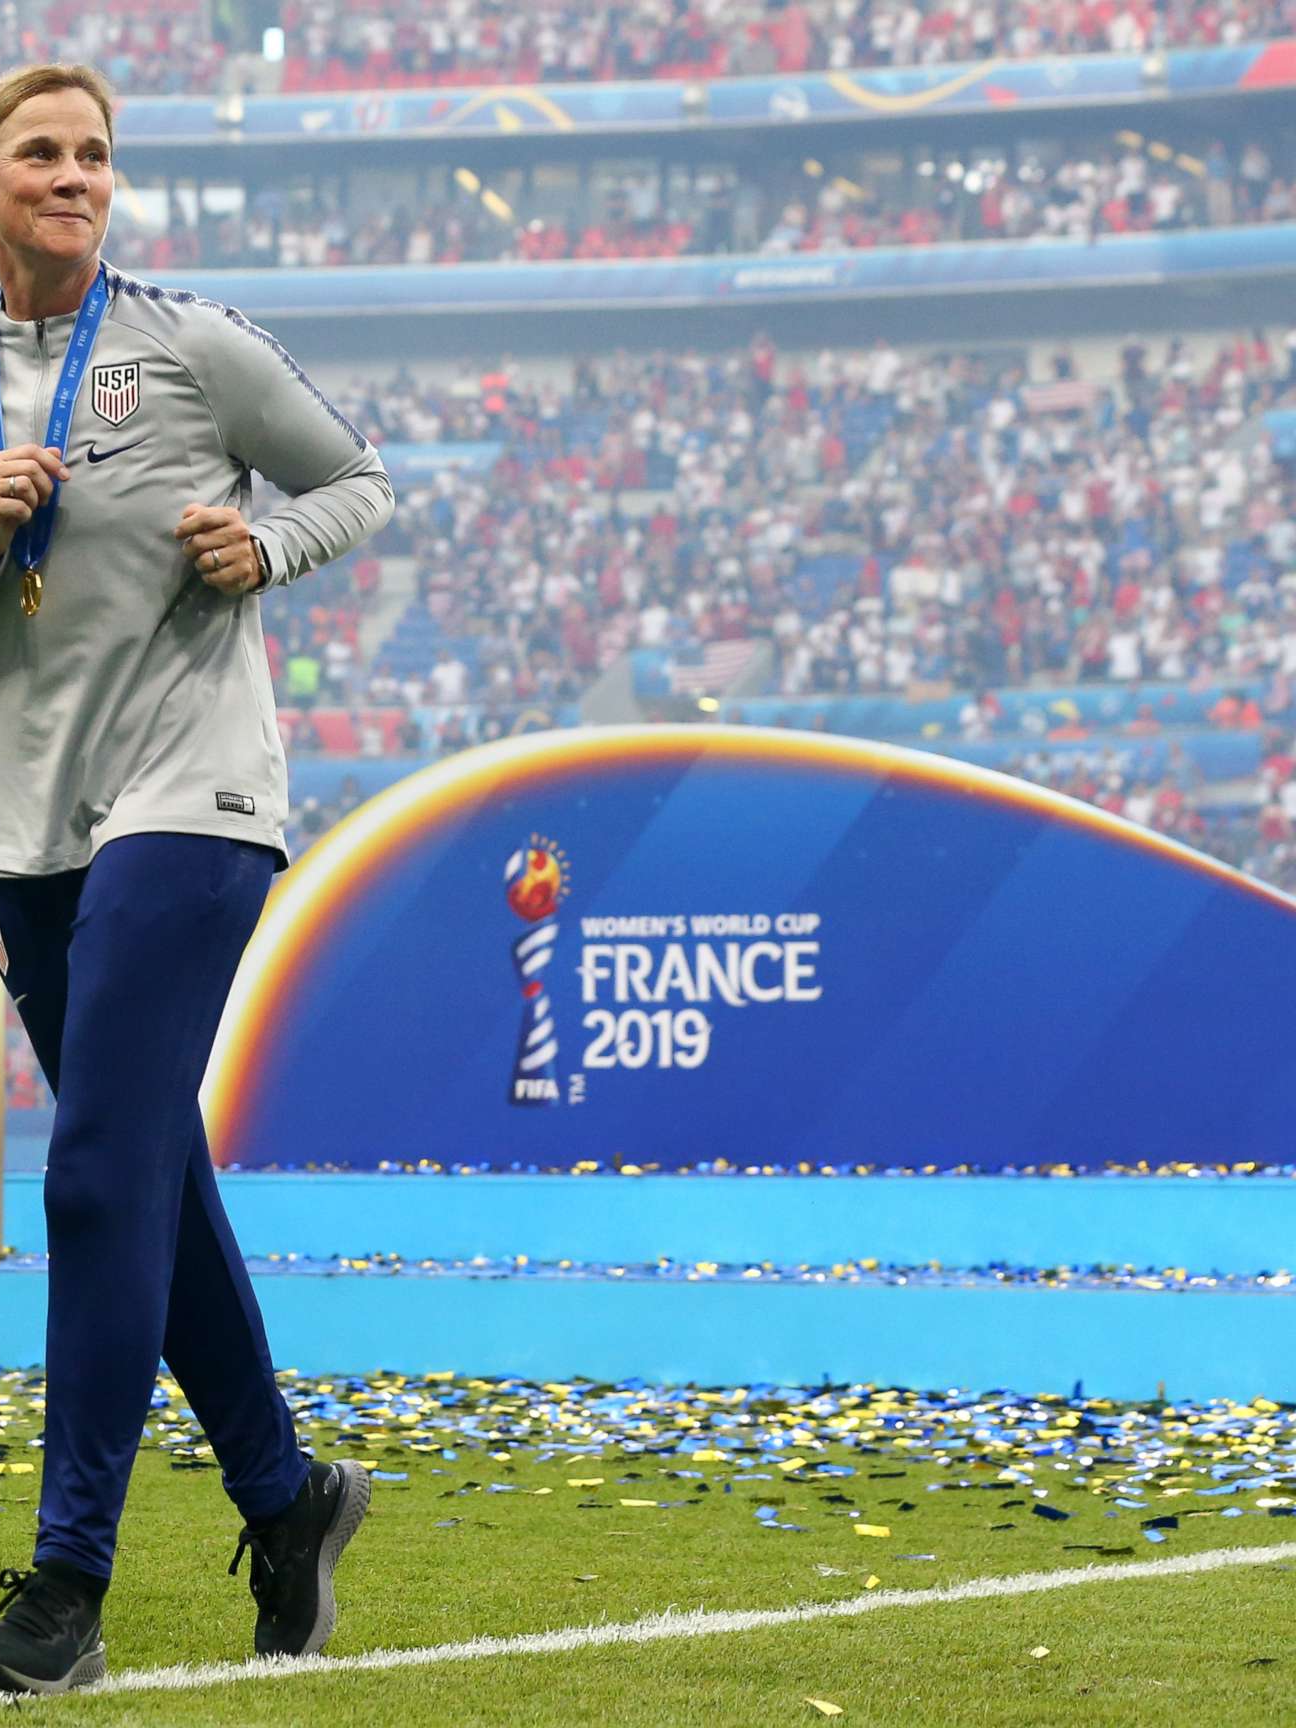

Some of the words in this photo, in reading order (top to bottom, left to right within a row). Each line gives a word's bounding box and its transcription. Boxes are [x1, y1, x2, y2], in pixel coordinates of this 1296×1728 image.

[98, 368, 134, 390] USA
[580, 916, 687, 938] WOMEN'S
[690, 915, 771, 937] WORLD
[775, 913, 822, 936] CUP
[576, 941, 823, 1007] FRANCE
[581, 1009, 713, 1069] 2019
[515, 1079, 560, 1101] FIFA
